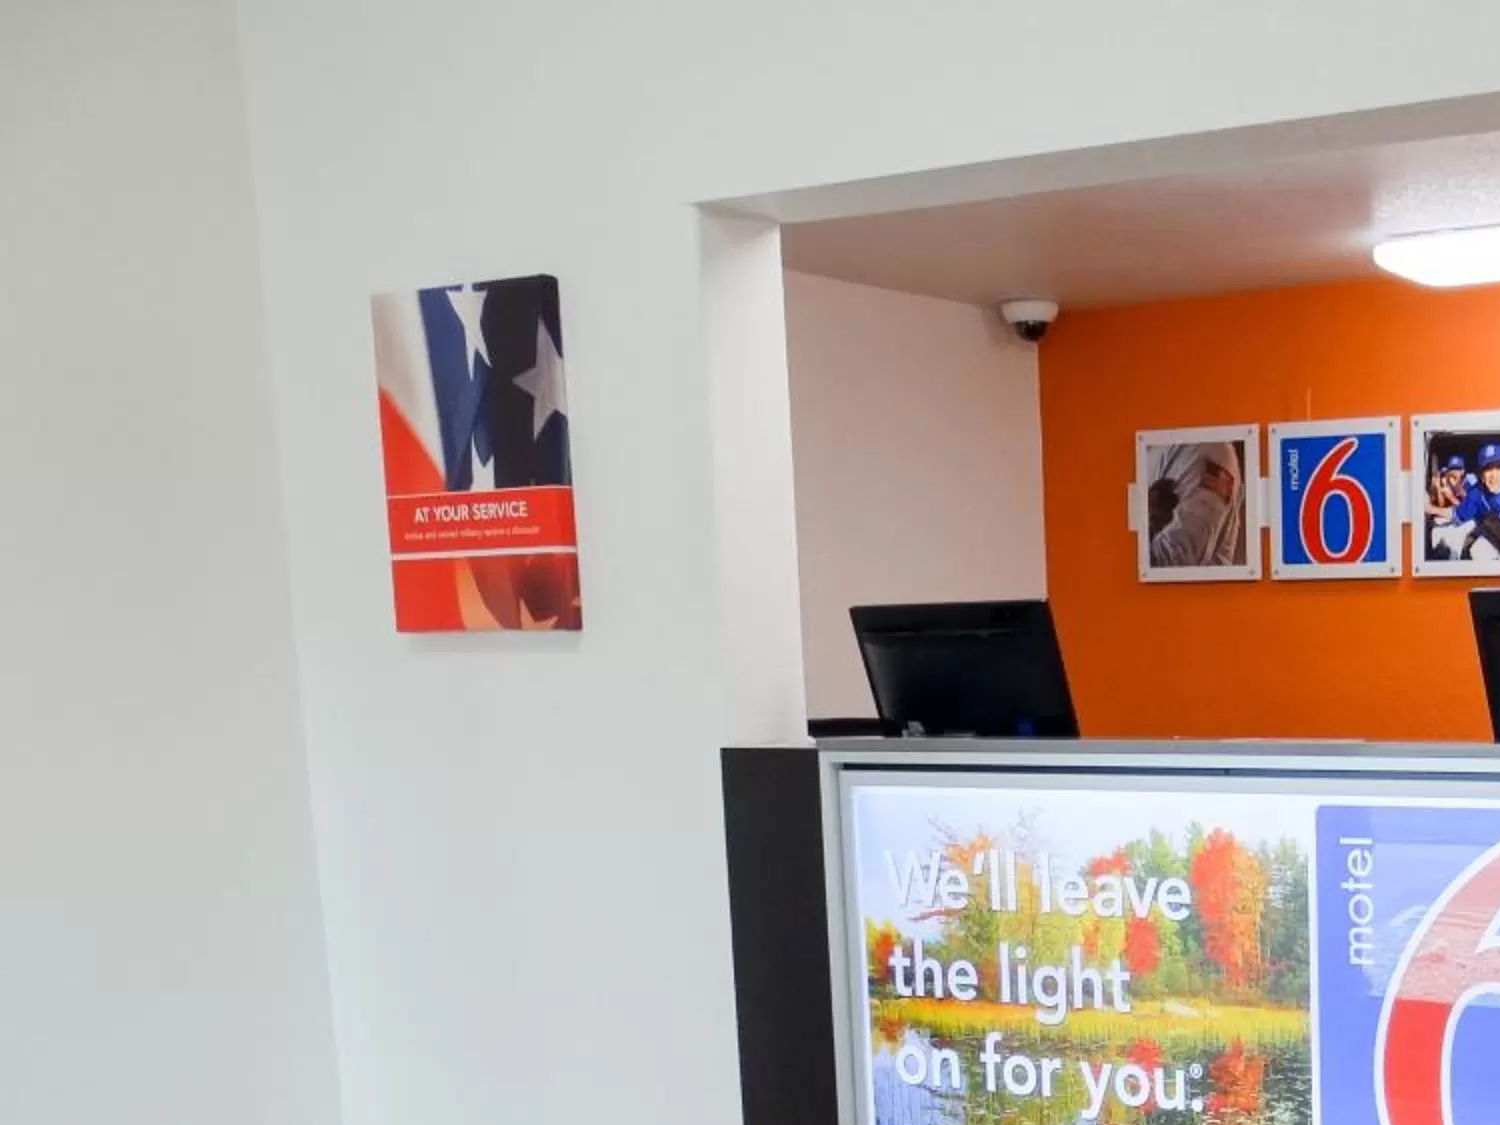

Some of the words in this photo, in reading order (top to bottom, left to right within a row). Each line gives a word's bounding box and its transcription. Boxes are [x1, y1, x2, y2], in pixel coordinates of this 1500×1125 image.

[1288, 448, 1299, 491] motel
[1299, 437, 1375, 565] 6
[415, 507, 429, 523] AT
[434, 504, 469, 522] YOUR
[472, 500, 529, 520] SERVICE
[885, 848, 1017, 912] We'll
[1040, 850, 1192, 921] leave
[1340, 836, 1374, 966] motel
[889, 936, 979, 1001] the
[1000, 941, 1131, 1026] light
[896, 1043, 961, 1089] on
[980, 1031, 1061, 1097] for
